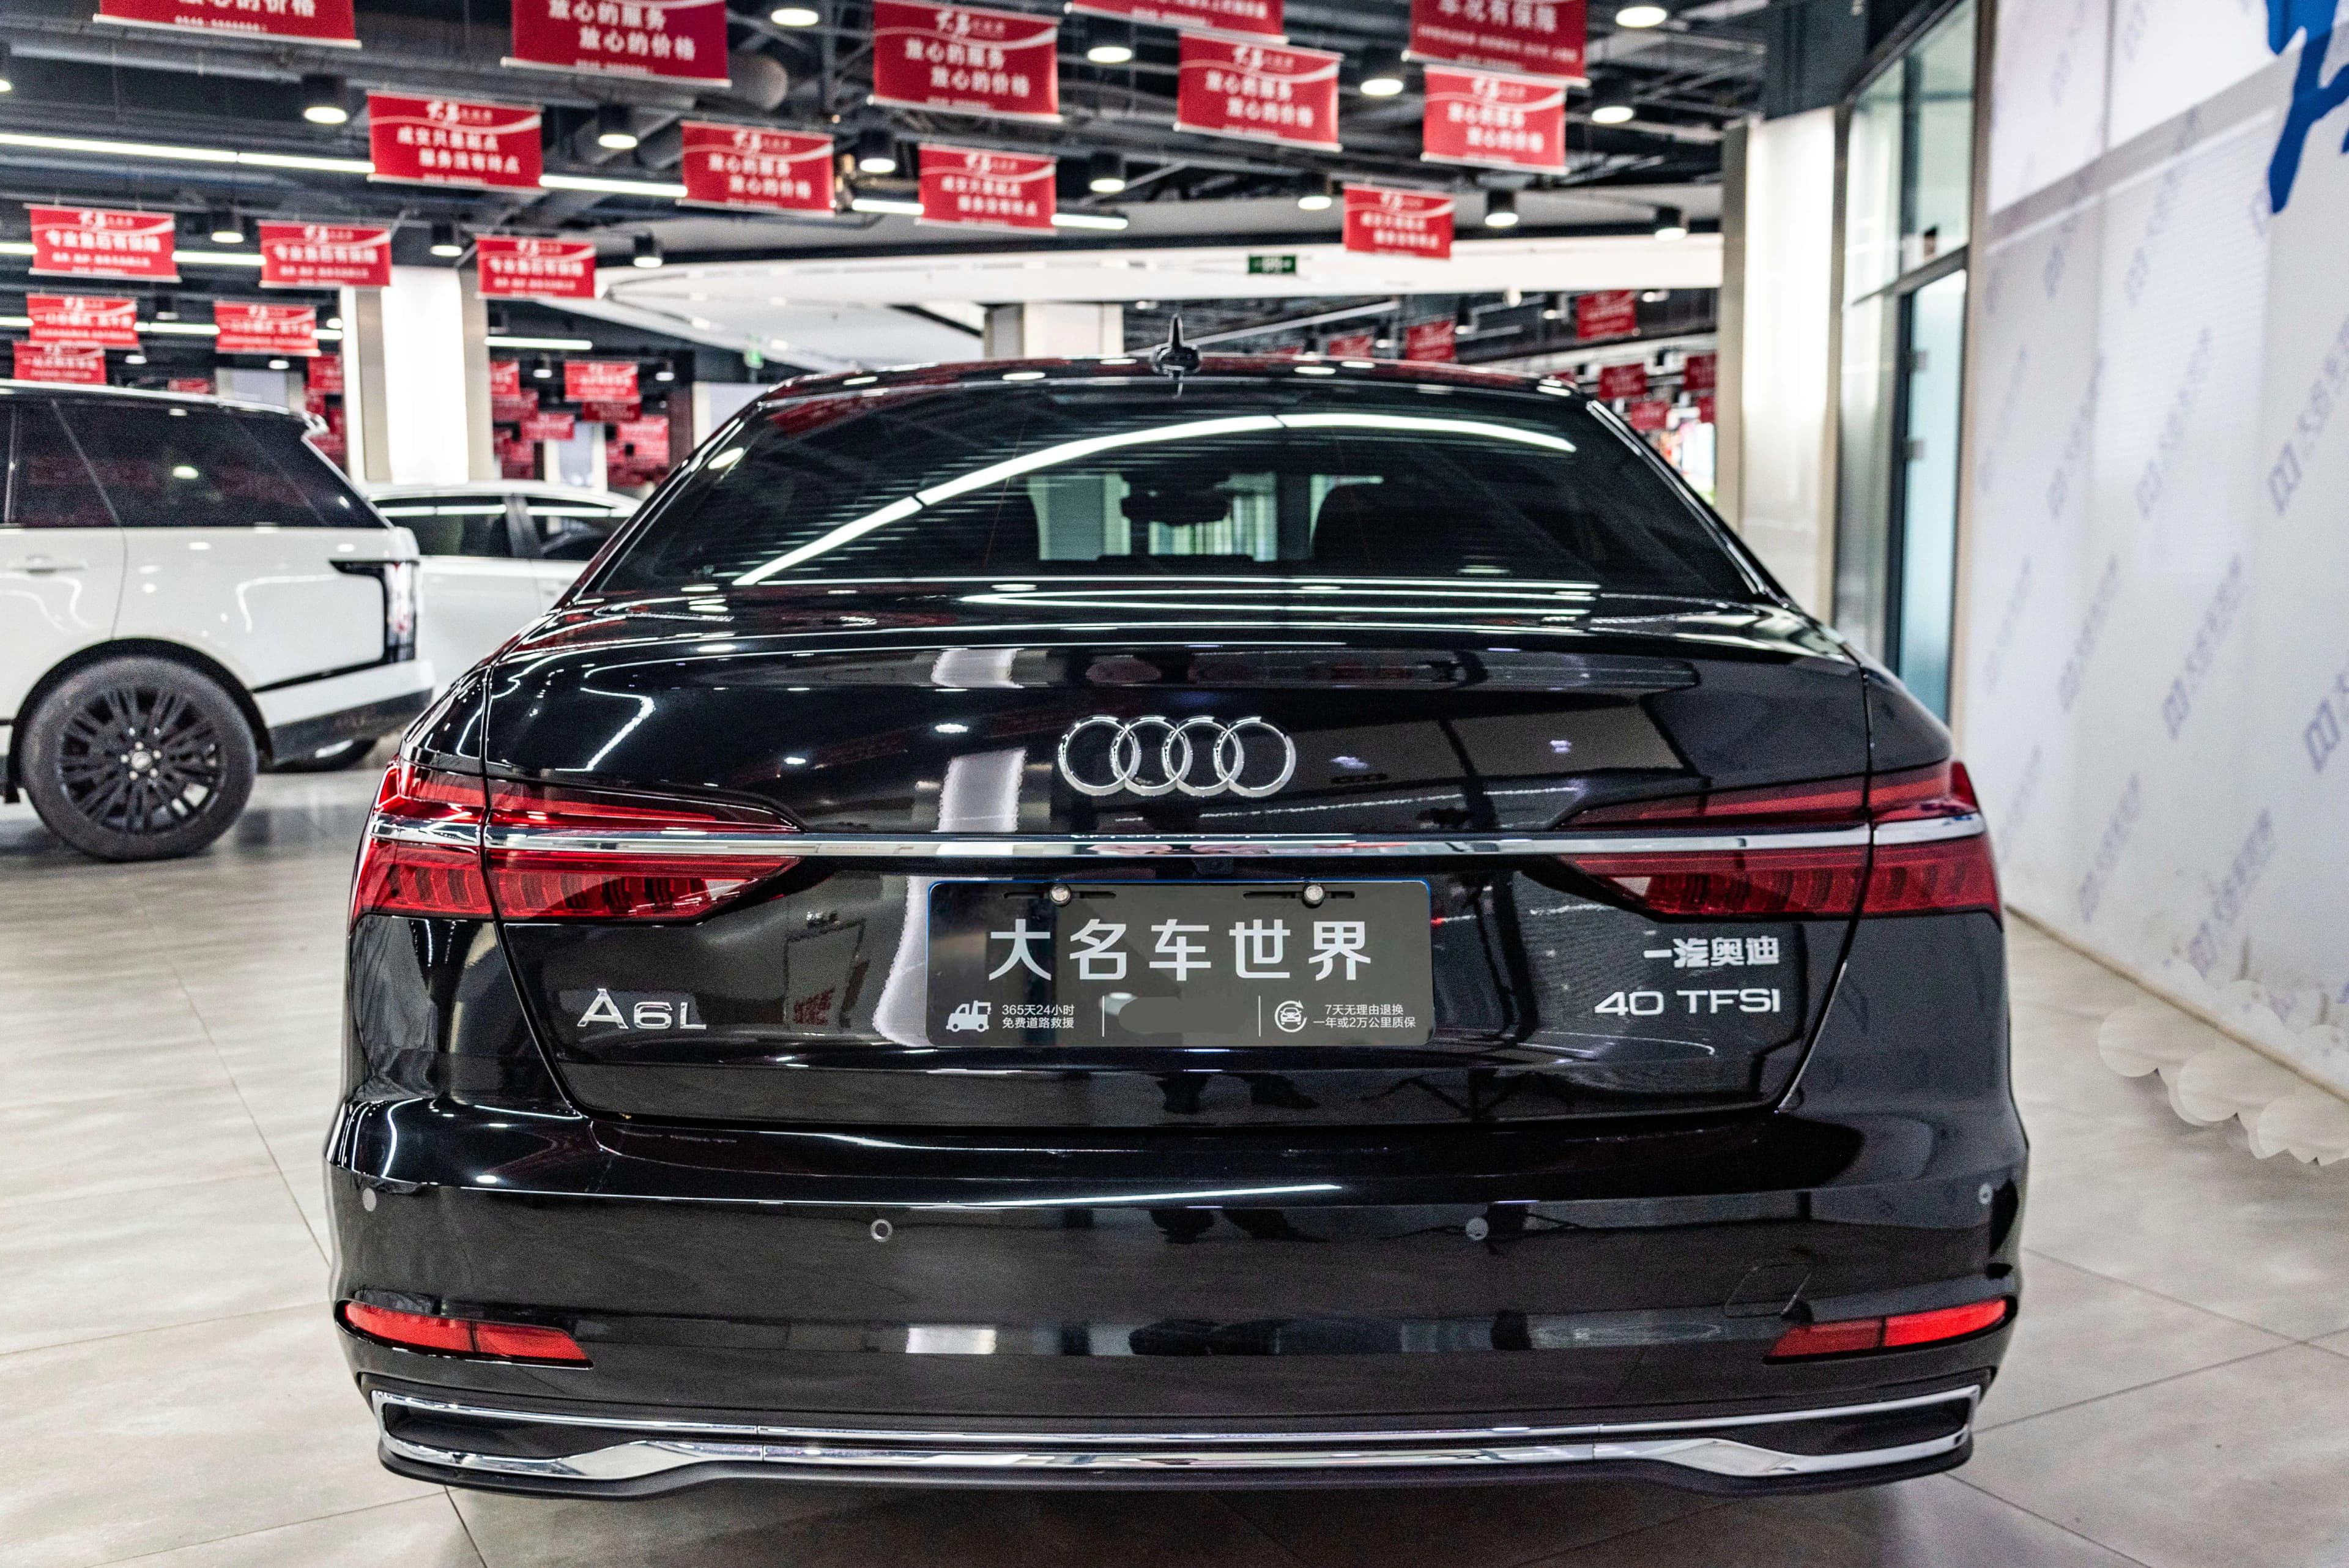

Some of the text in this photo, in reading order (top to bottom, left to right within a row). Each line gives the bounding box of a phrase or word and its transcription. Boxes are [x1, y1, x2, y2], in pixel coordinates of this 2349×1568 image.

[579, 26, 696, 61] 放心的价格
[989, 919, 1371, 981] 大名车世界
[1644, 936, 1779, 968] 一汽奥迪
[577, 989, 707, 1030] A6L
[1002, 1005, 1074, 1016] 365天24小时
[1325, 1004, 1404, 1016] 7天无理由退换
[1595, 989, 1780, 1016] 40 TFSI
[1003, 1017, 1074, 1029] 免费道路救援
[1313, 1017, 1416, 1028] 一年或2万公里质保
